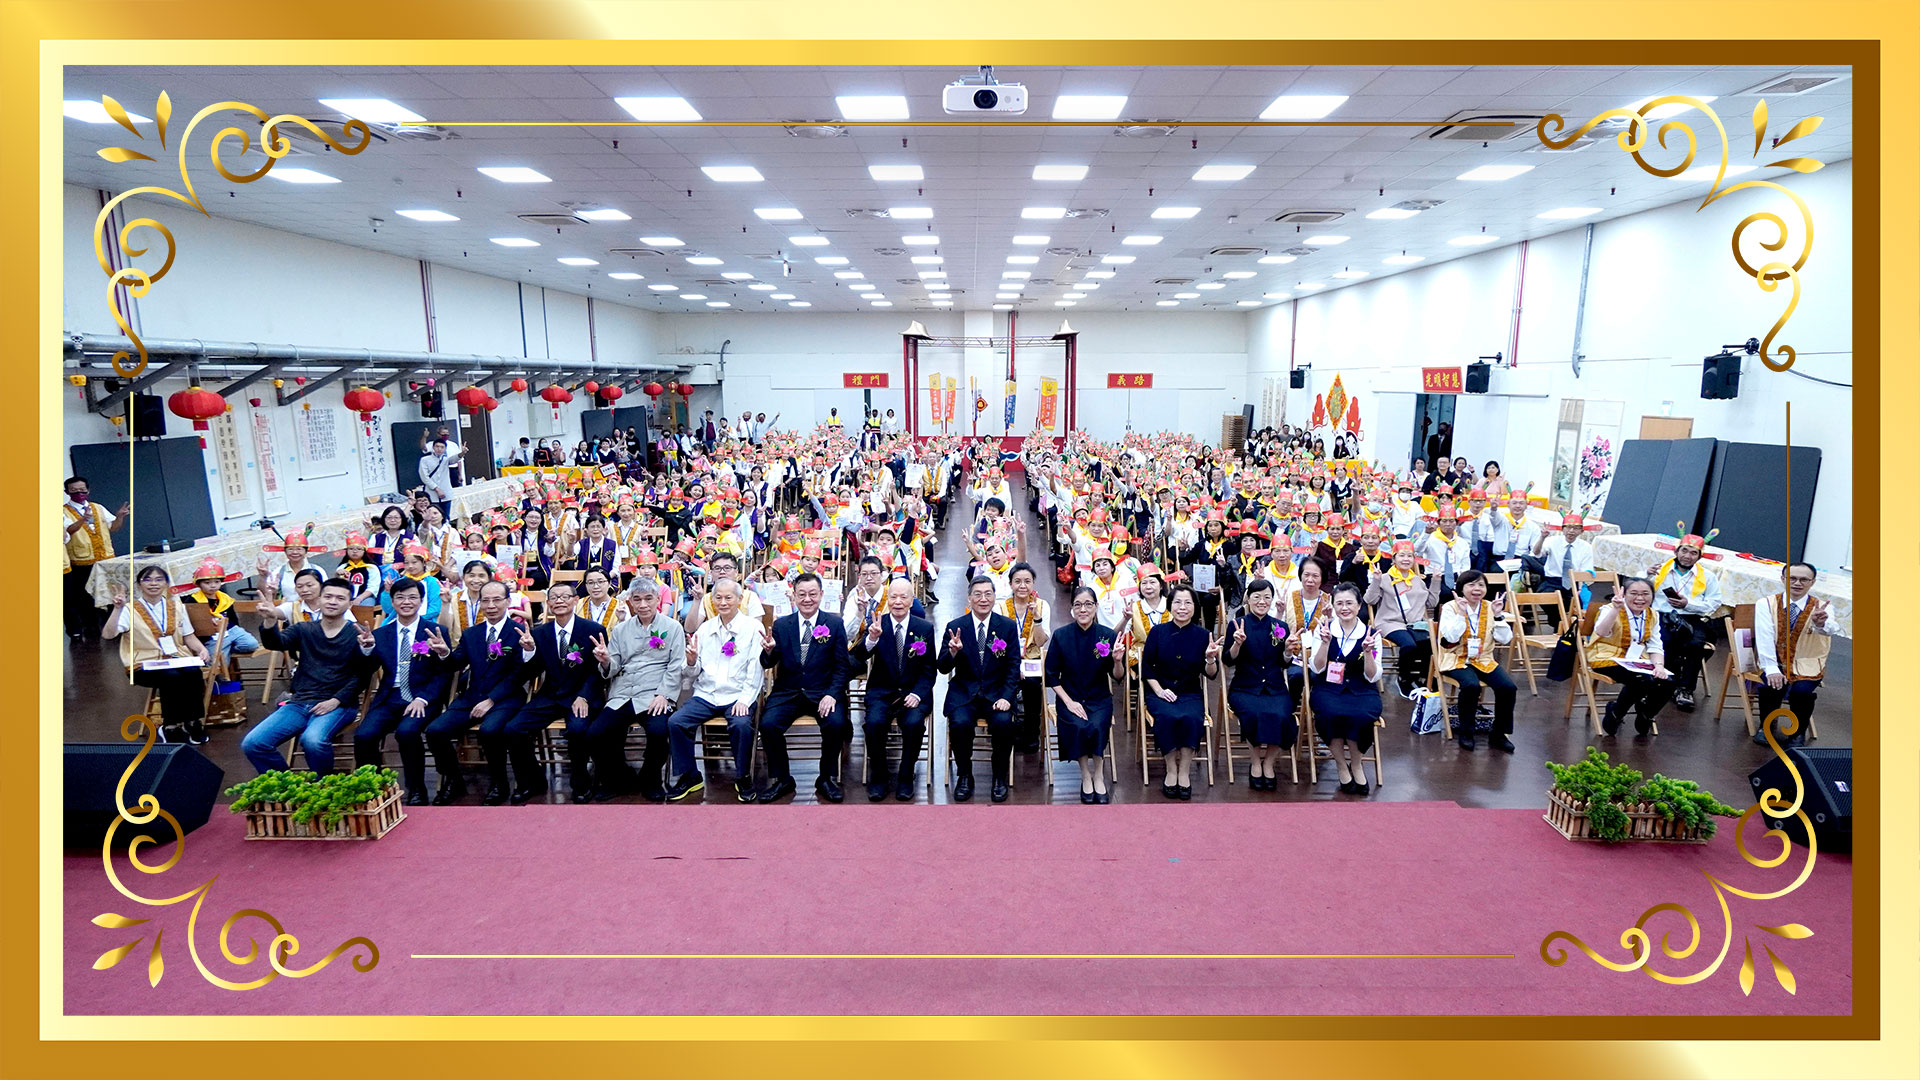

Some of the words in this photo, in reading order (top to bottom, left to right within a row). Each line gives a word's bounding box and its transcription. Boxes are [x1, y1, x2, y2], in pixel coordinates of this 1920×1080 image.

[852, 375, 880, 386] 禮門
[1117, 374, 1144, 386] 義路
[1425, 372, 1460, 387] 光明智慧
